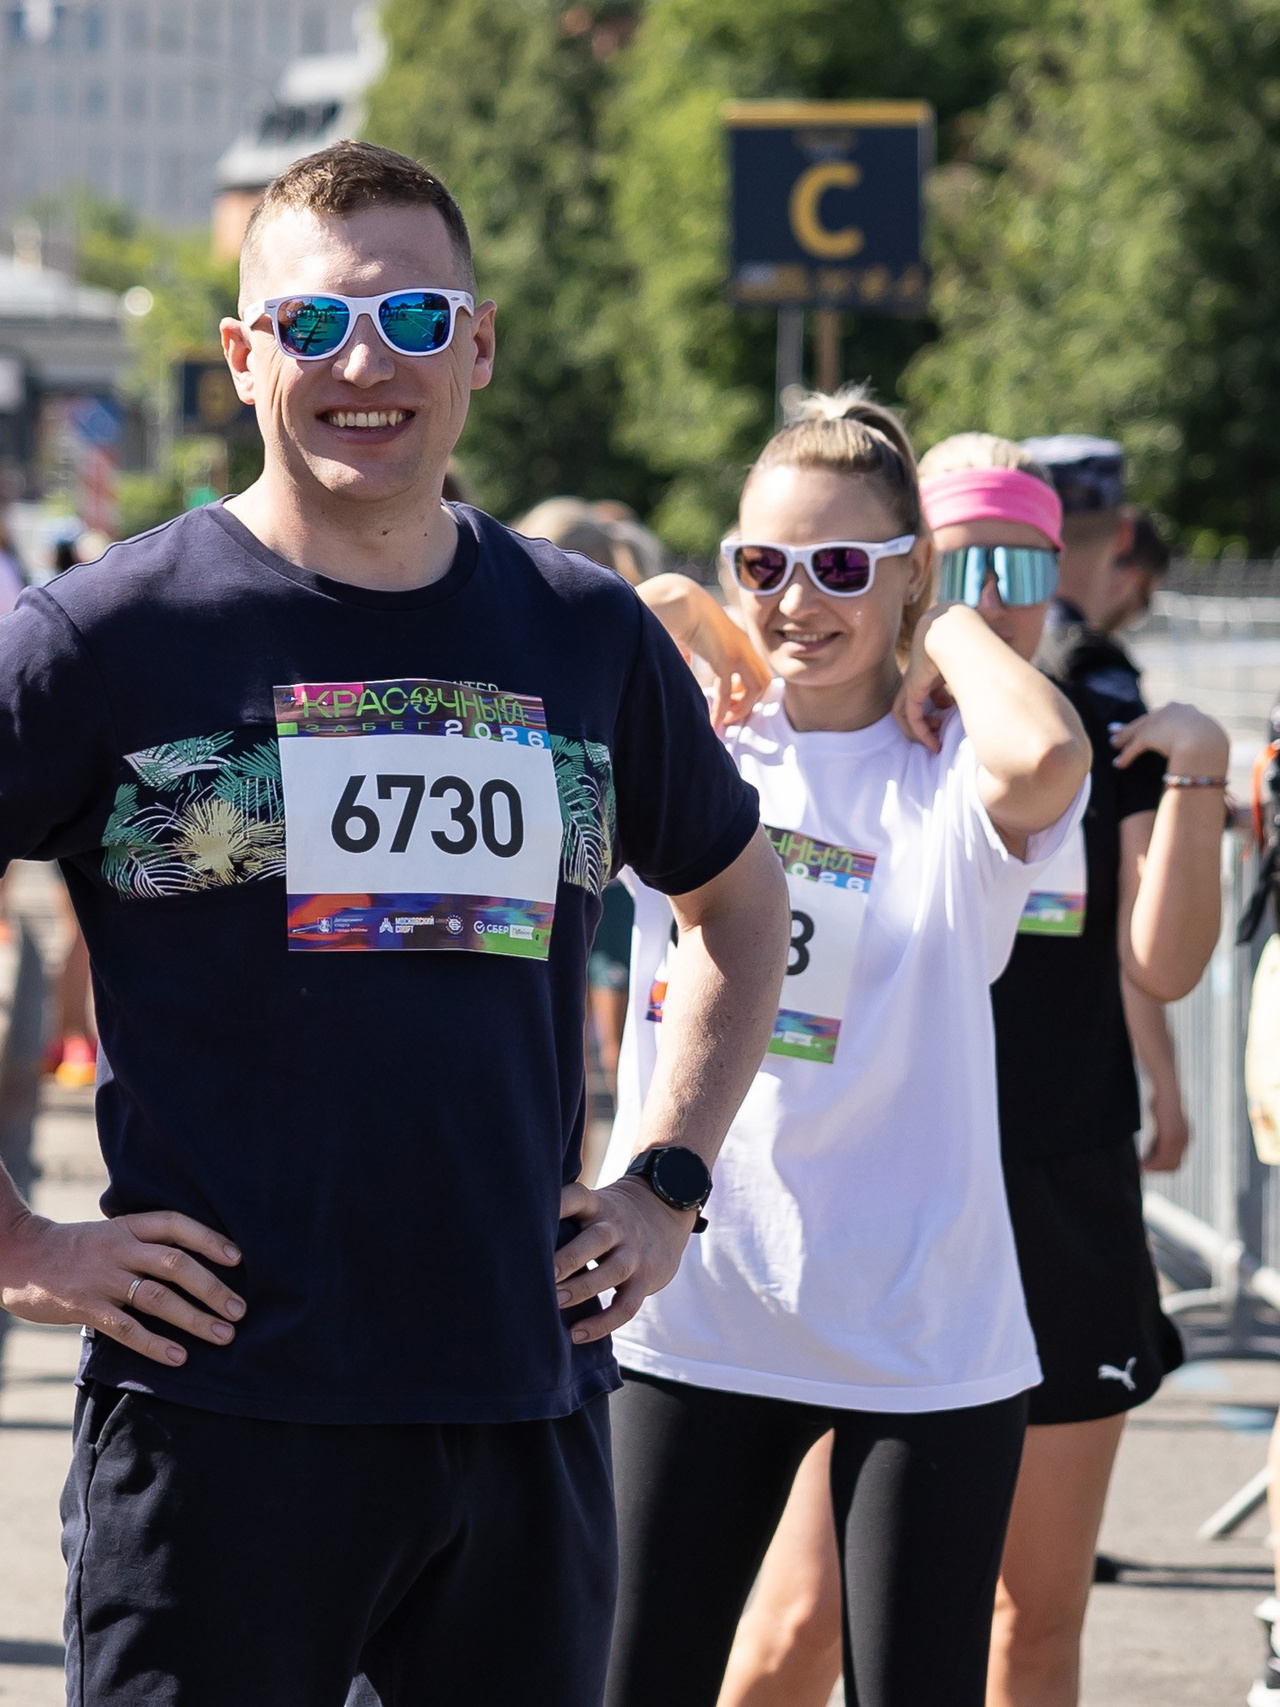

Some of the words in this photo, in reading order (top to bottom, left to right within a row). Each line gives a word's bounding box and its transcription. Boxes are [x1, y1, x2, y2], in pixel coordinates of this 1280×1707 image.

[788, 163, 864, 261] C
[301, 686, 527, 727] КРАСОЧНЫЙ
[305, 720, 431, 732] ЗАБЕГ
[444, 719, 545, 749] 2026
[331, 774, 524, 859] 6730
[486, 923, 509, 934] СБЕР
